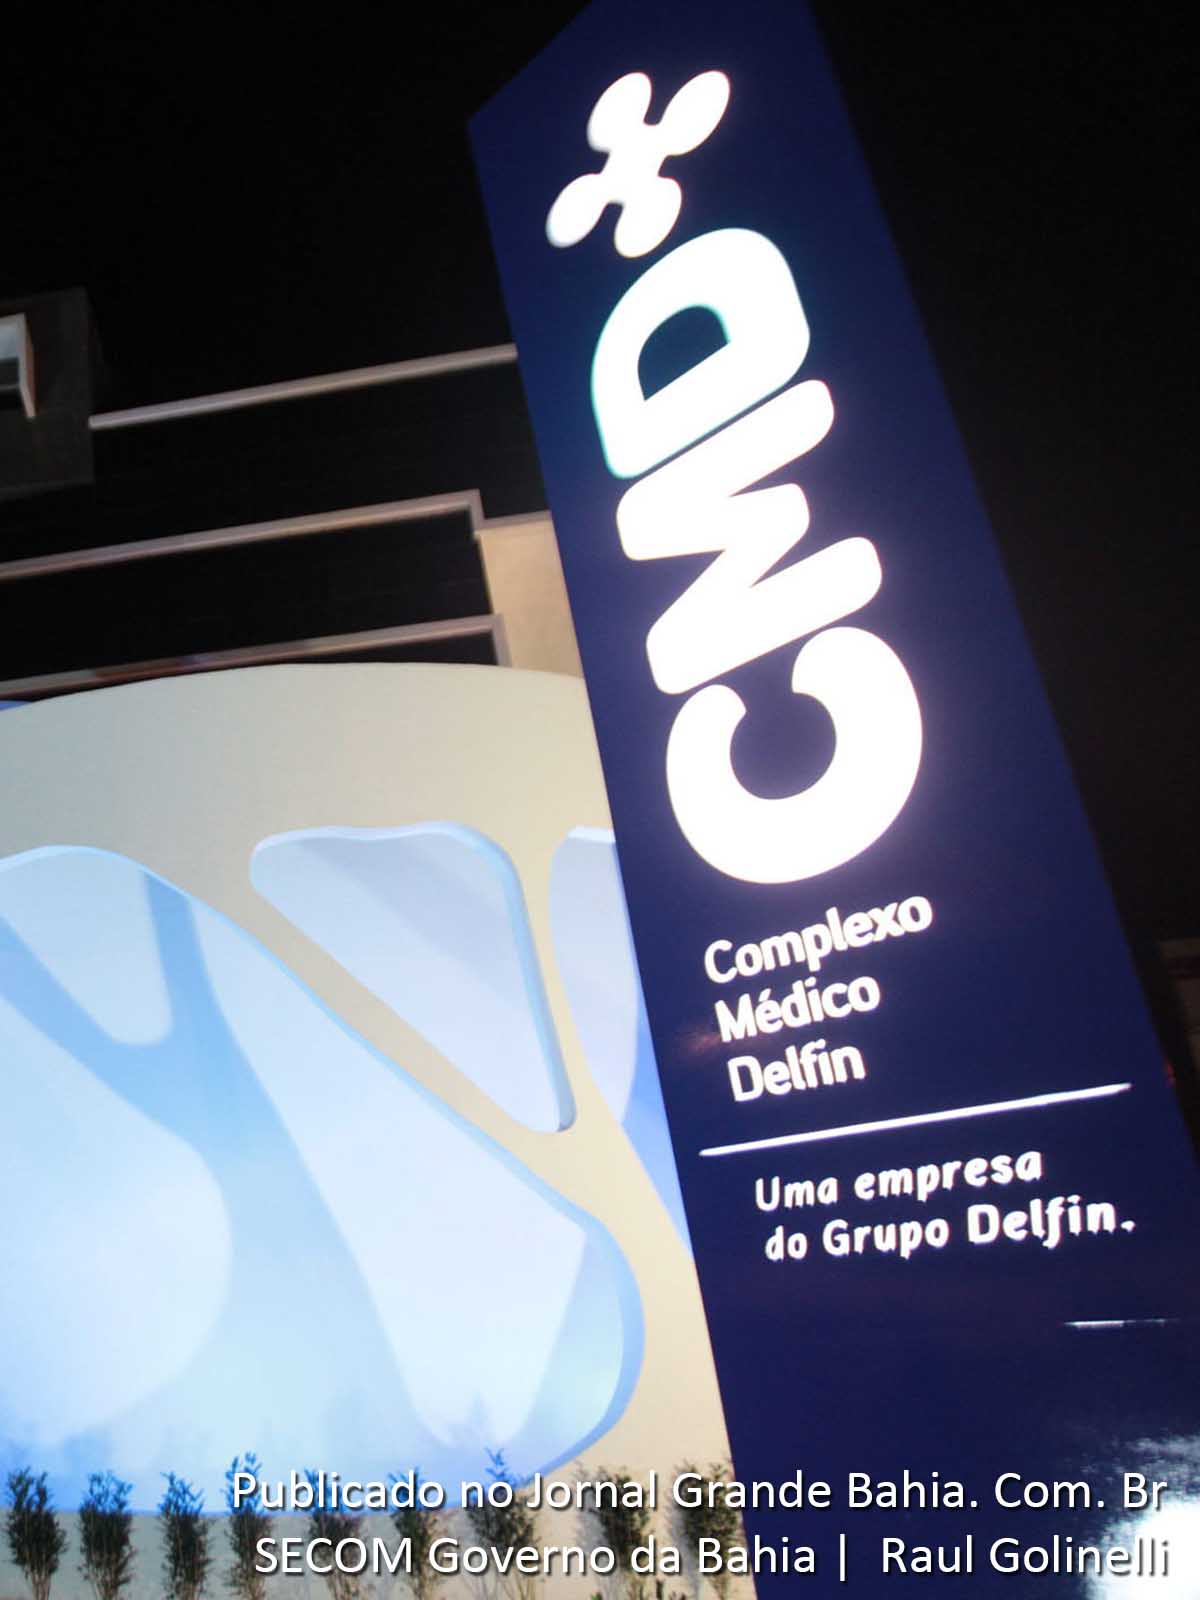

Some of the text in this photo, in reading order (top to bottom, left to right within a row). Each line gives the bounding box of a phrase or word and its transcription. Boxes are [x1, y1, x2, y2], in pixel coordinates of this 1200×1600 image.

[591, 227, 924, 884] CMD
[704, 896, 933, 983] Complexo
[714, 976, 881, 1042] Médico
[728, 1039, 866, 1102] Delfin
[756, 1151, 1042, 1211] Uma empresa
[765, 1195, 1136, 1261] do Grupo Delfin.
